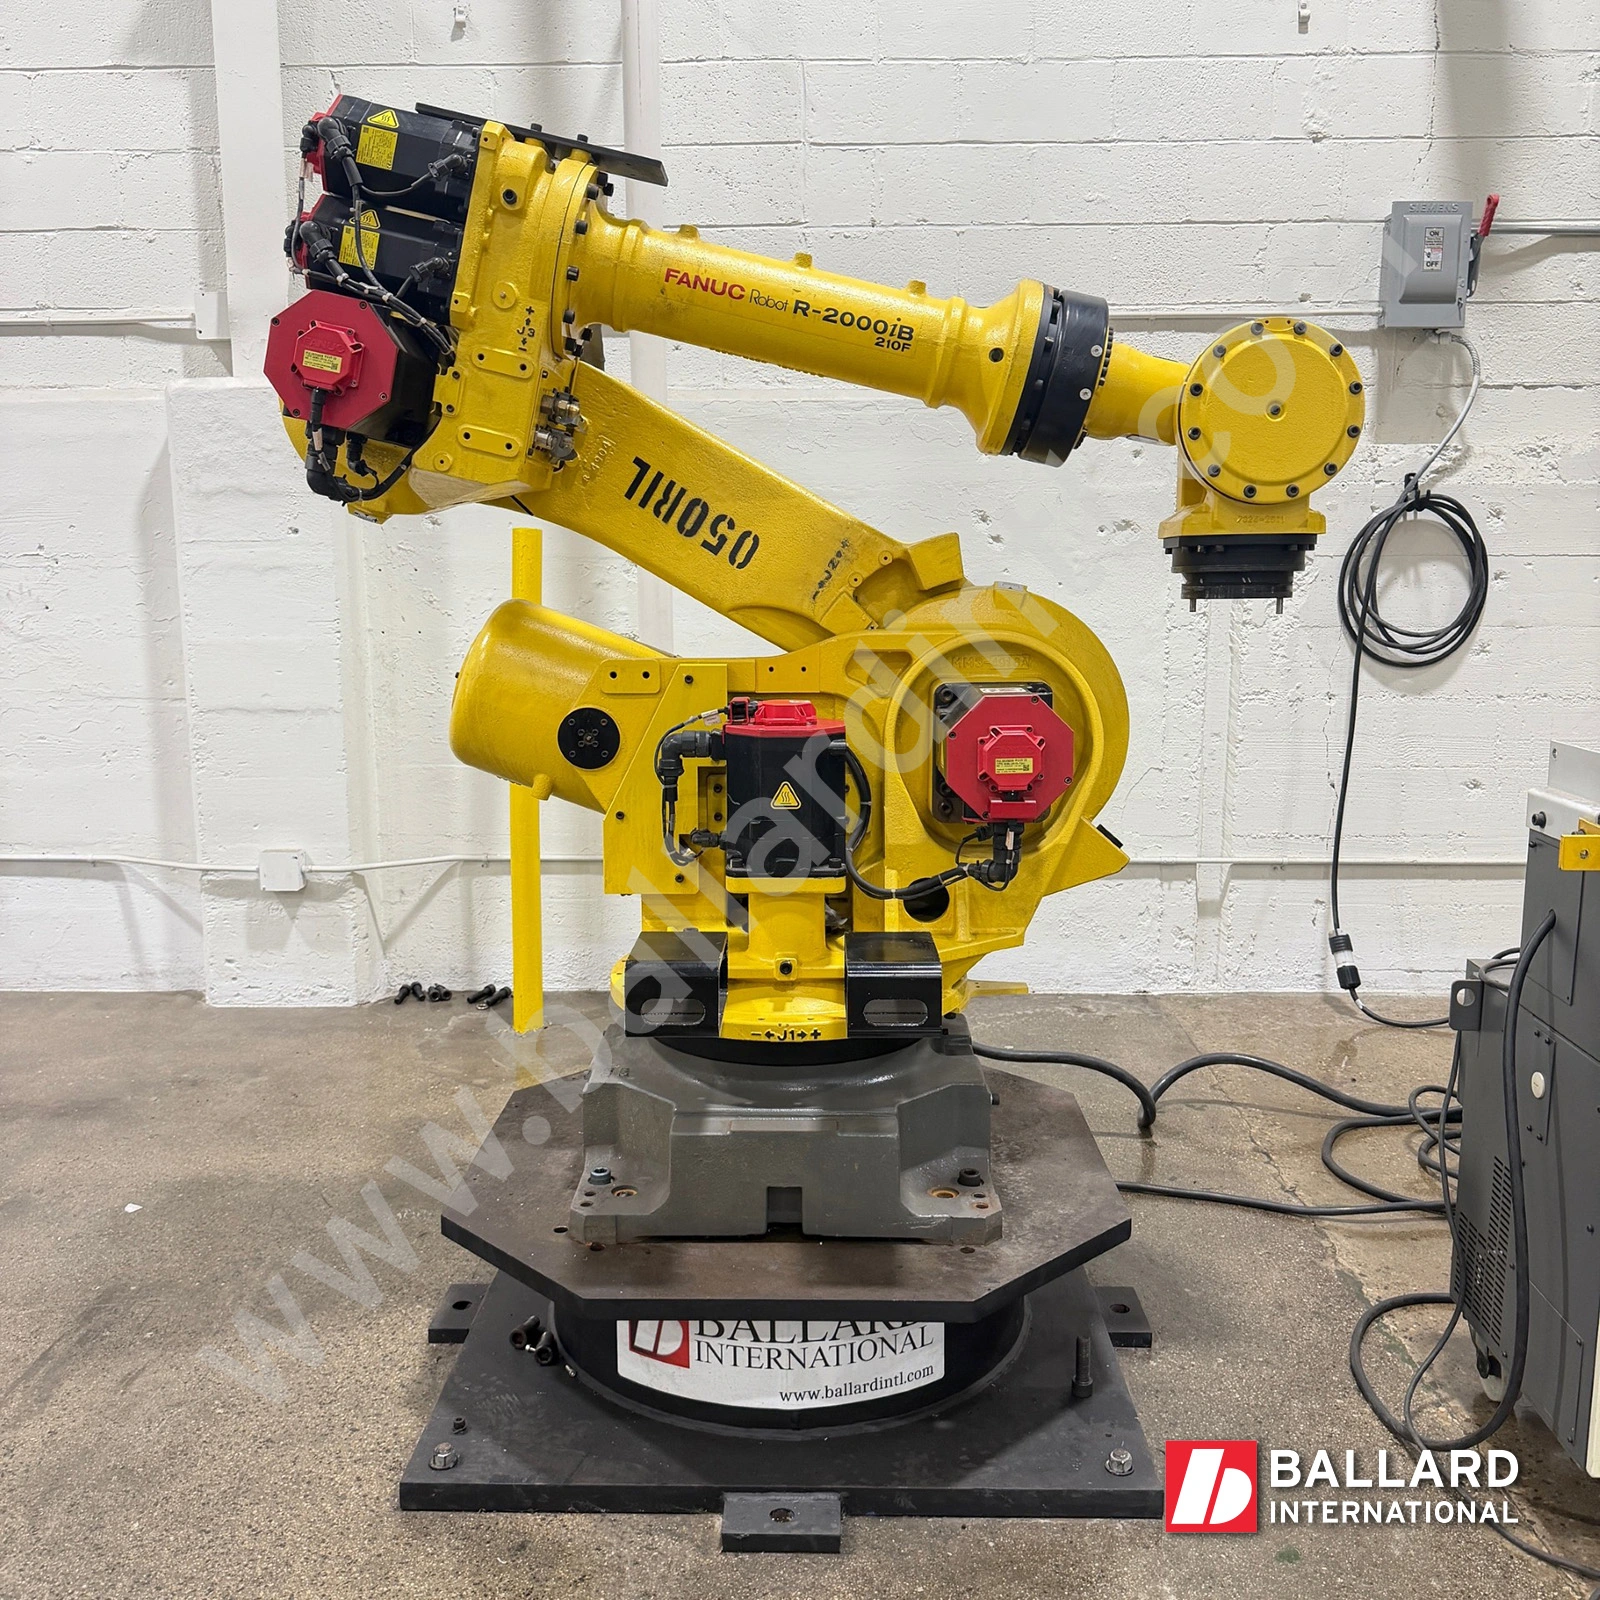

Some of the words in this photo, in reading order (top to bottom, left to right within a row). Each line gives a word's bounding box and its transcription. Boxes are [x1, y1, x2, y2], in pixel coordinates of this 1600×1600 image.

[1408, 203, 1460, 213] SIEMENS
[664, 267, 747, 301] FANUC
[749, 288, 790, 312] Robot
[792, 299, 915, 342] R-2000iB
[873, 336, 912, 352] 210F
[777, 1029, 796, 1041] J1
[694, 1324, 935, 1371] INTERNATIONAL
[779, 1364, 935, 1402] www.ballardintl.com
